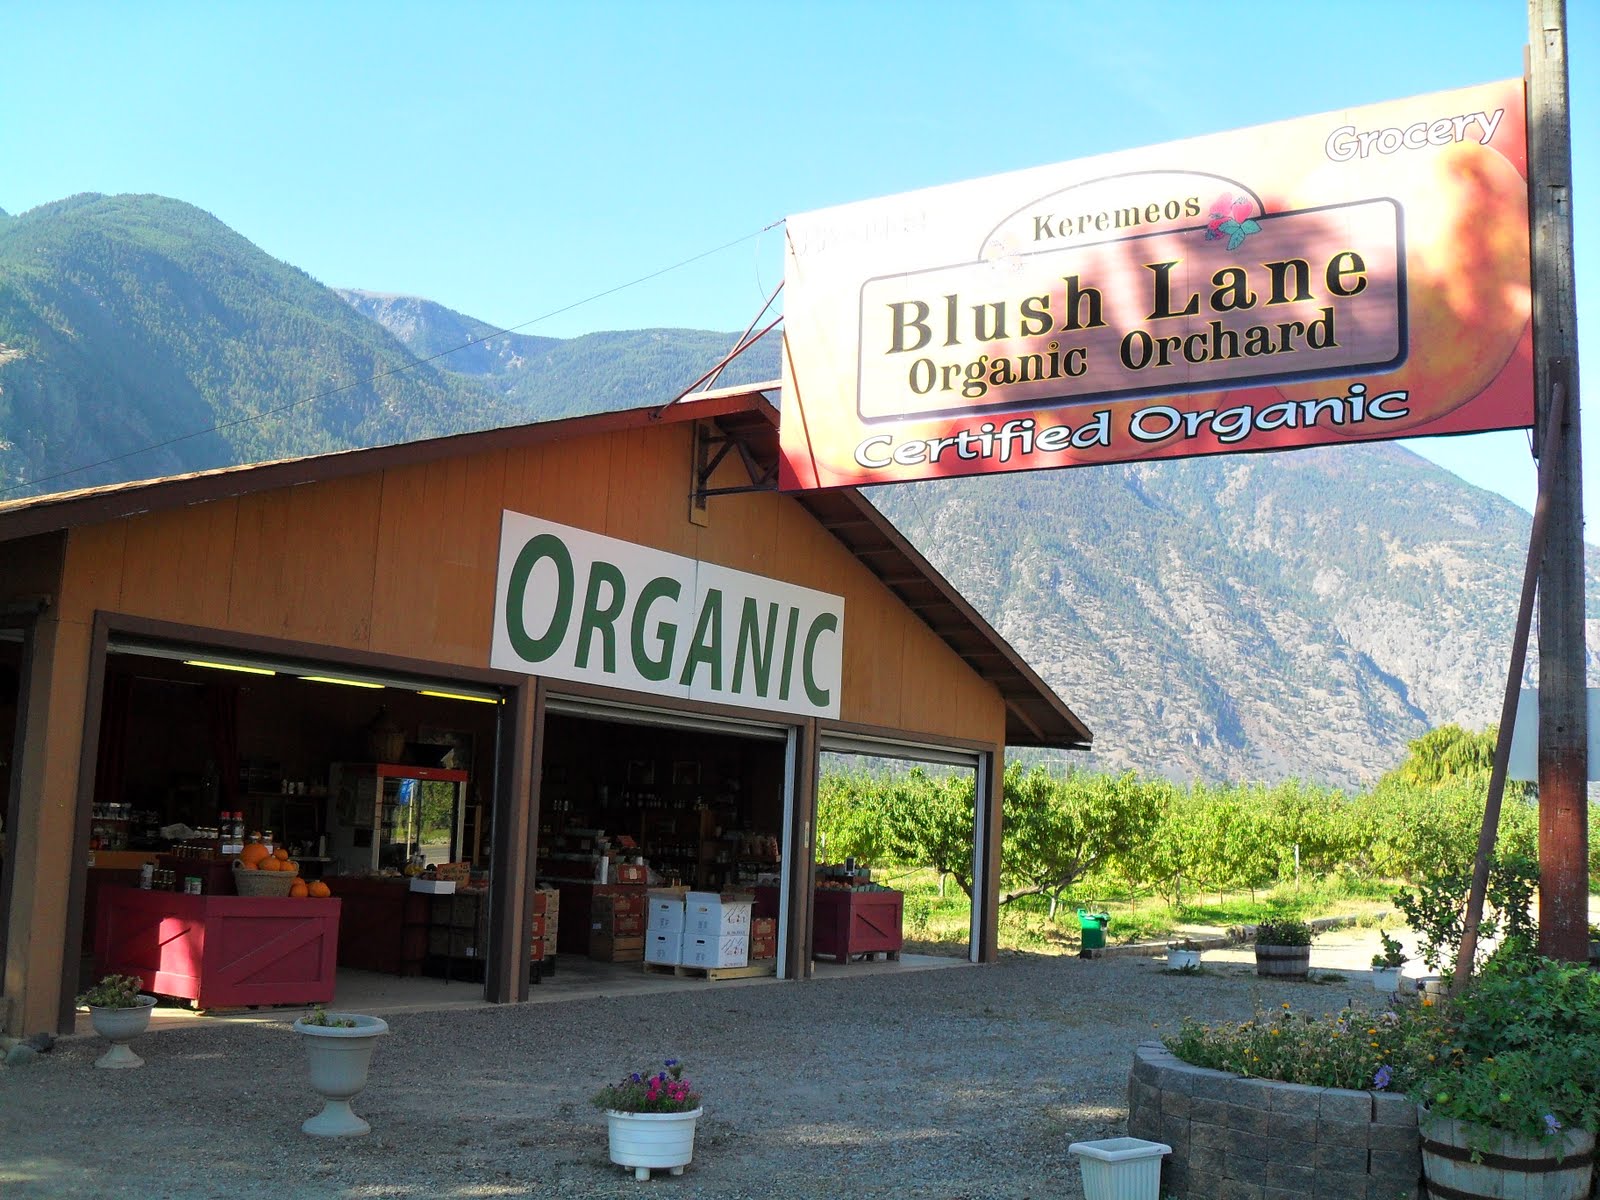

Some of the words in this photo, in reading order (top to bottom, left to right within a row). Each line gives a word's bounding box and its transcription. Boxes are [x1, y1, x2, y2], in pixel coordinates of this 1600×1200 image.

[1325, 108, 1504, 162] Grocery
[1033, 194, 1201, 242] Keremeos
[886, 275, 1106, 355] Blush
[1144, 250, 1368, 321] Lane
[908, 341, 1088, 398] Organic
[1119, 308, 1339, 371] Orchard
[854, 411, 1110, 469] Certified
[1128, 384, 1409, 444] Organic
[505, 533, 838, 708] ORGANIC
